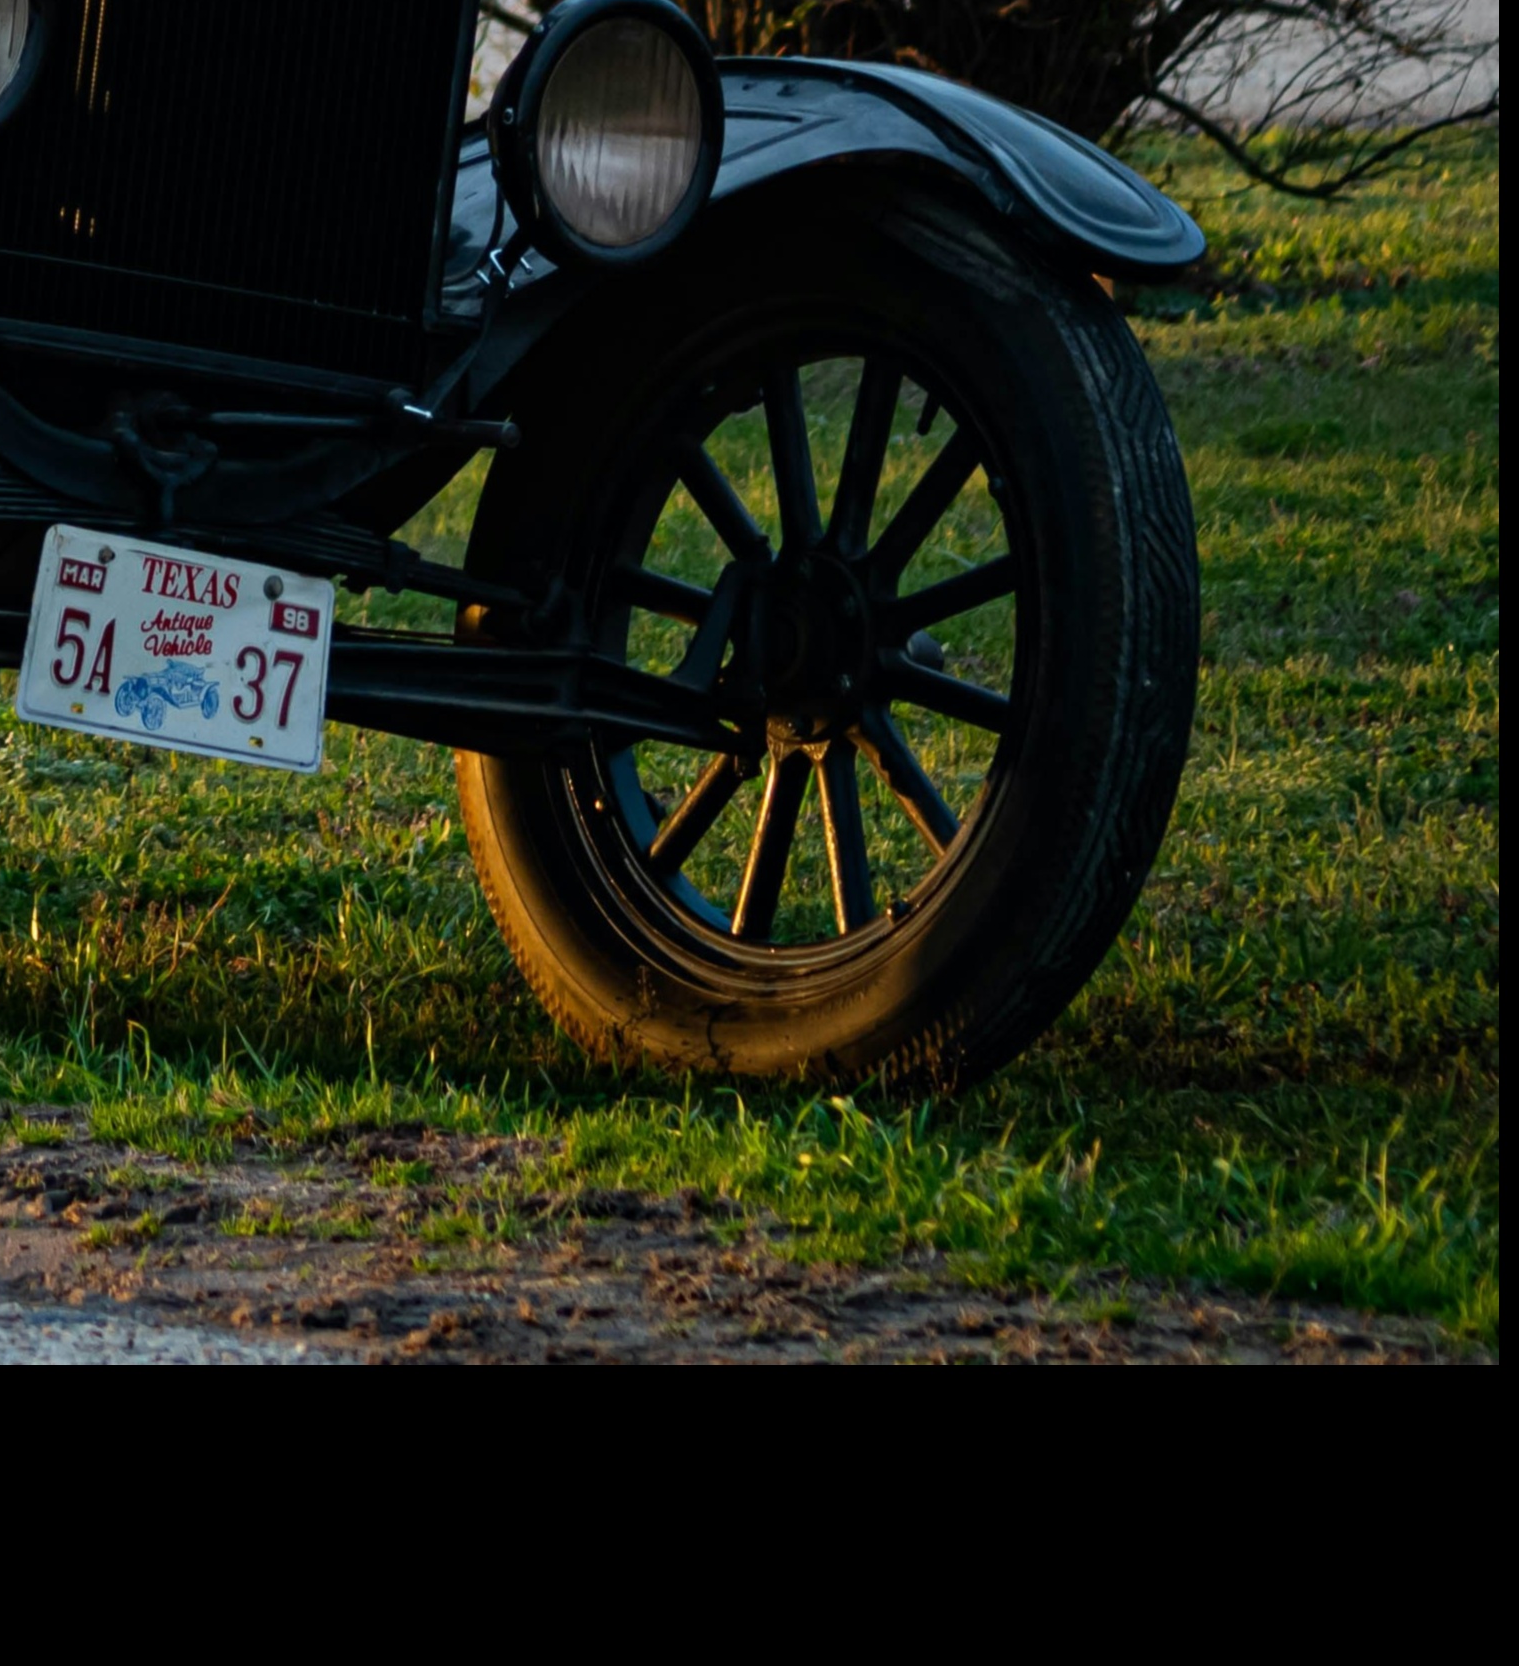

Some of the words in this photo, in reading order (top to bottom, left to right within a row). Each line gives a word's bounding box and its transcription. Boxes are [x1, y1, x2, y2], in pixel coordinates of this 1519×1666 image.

[62, 562, 104, 589] MAR
[141, 557, 241, 609] TEXAS
[140, 608, 214, 638] Antique
[282, 607, 310, 632] 98
[143, 632, 213, 657] Vehicle
[53, 606, 116, 694] 5A
[233, 645, 305, 727] 37
